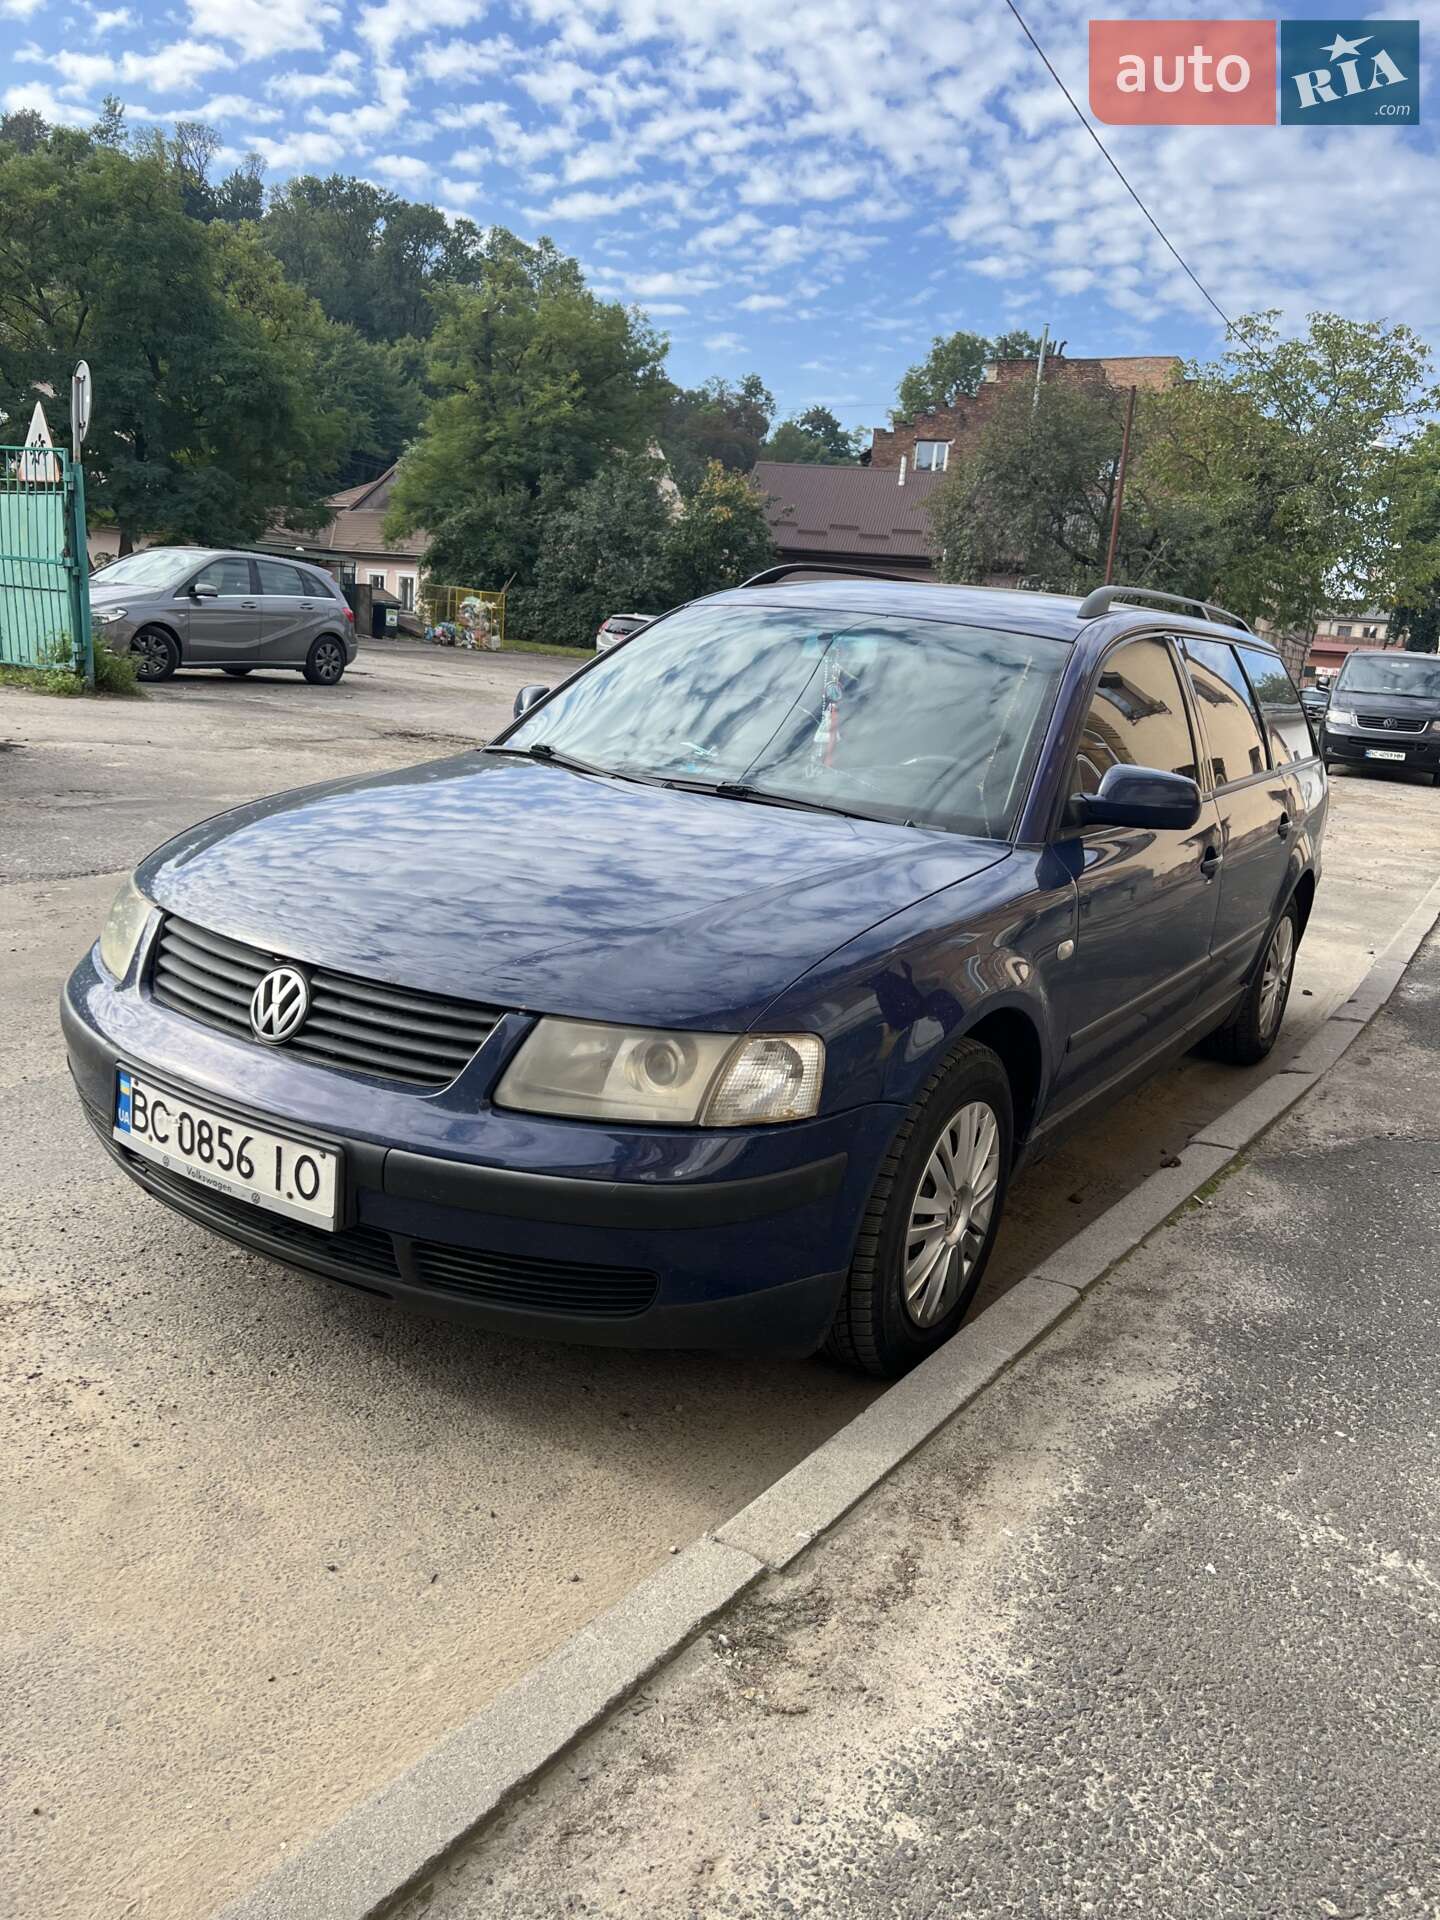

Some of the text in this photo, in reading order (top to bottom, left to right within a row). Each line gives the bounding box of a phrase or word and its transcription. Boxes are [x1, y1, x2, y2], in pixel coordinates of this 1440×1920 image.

[118, 1107, 130, 1125] UA
[132, 1087, 171, 1144] BC
[178, 1111, 255, 1180] 0856
[186, 1165, 233, 1193] Volkswagen
